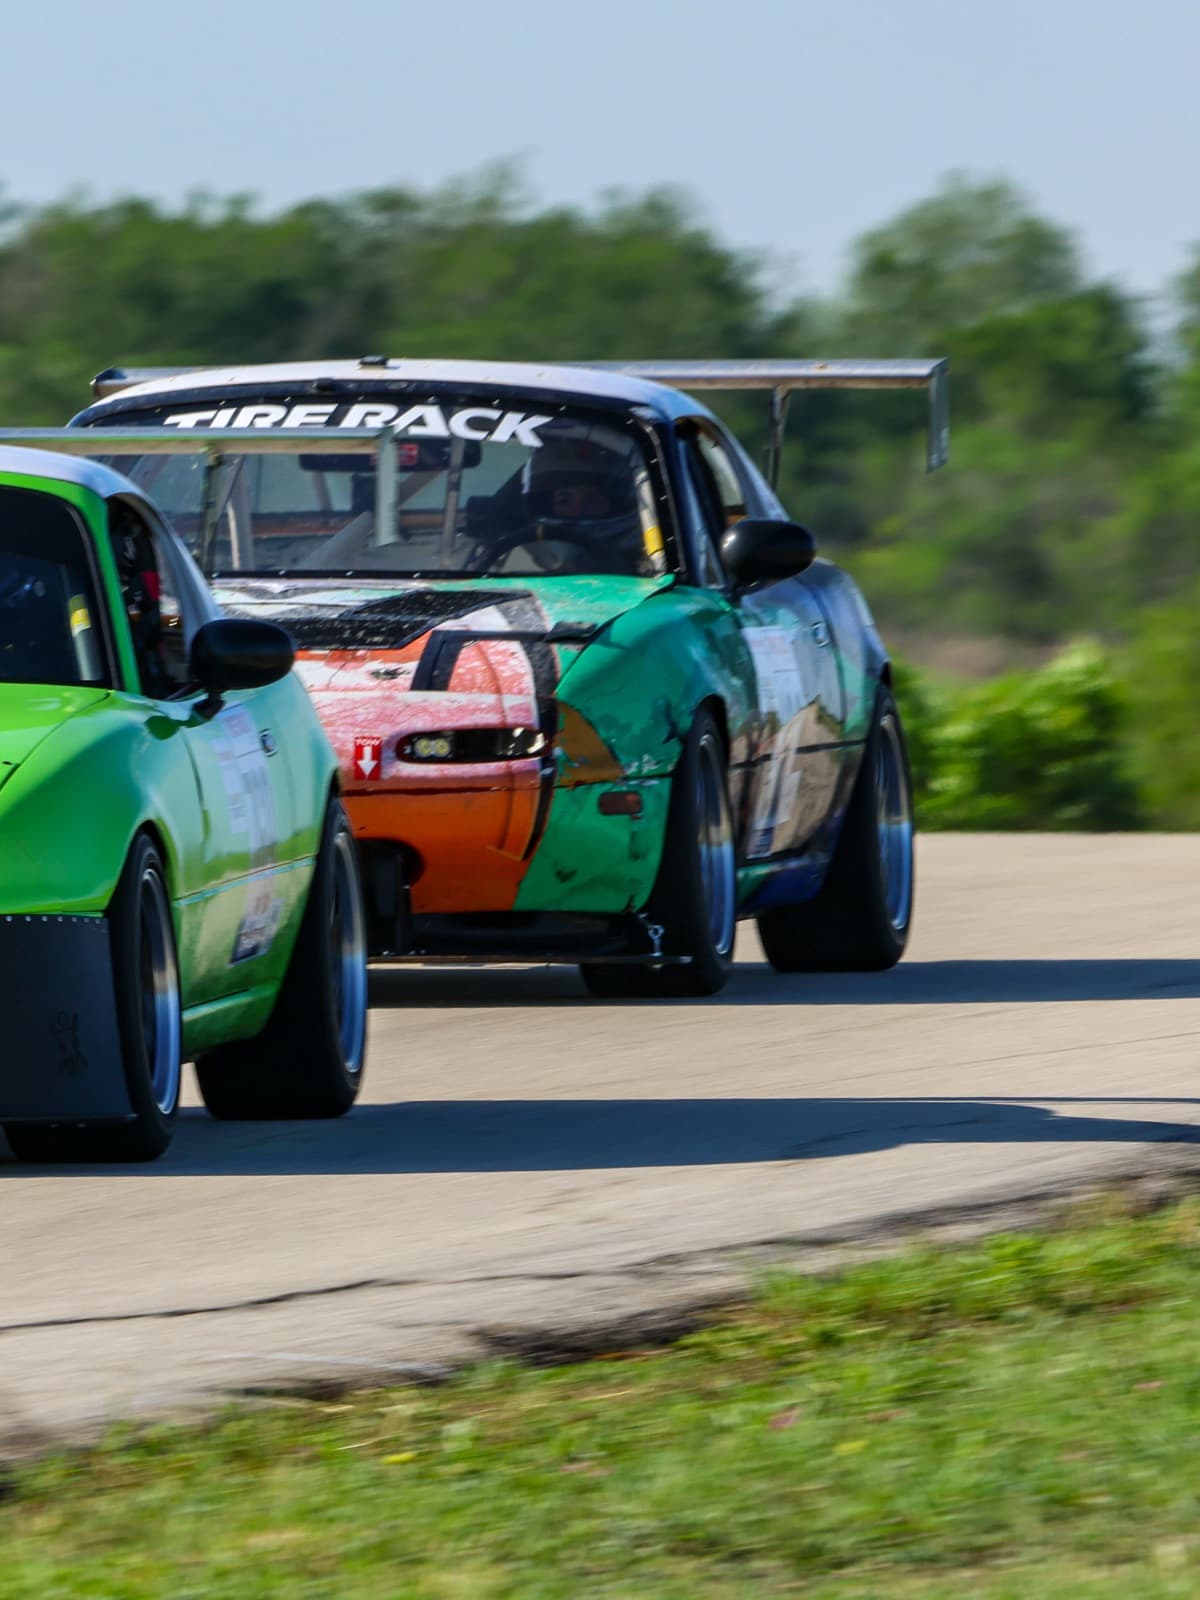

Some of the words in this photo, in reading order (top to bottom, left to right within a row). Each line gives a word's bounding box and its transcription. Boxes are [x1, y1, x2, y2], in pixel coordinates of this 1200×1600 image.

[163, 403, 338, 428] TIRE
[339, 403, 554, 448] RACK
[354, 738, 381, 747] TOW
